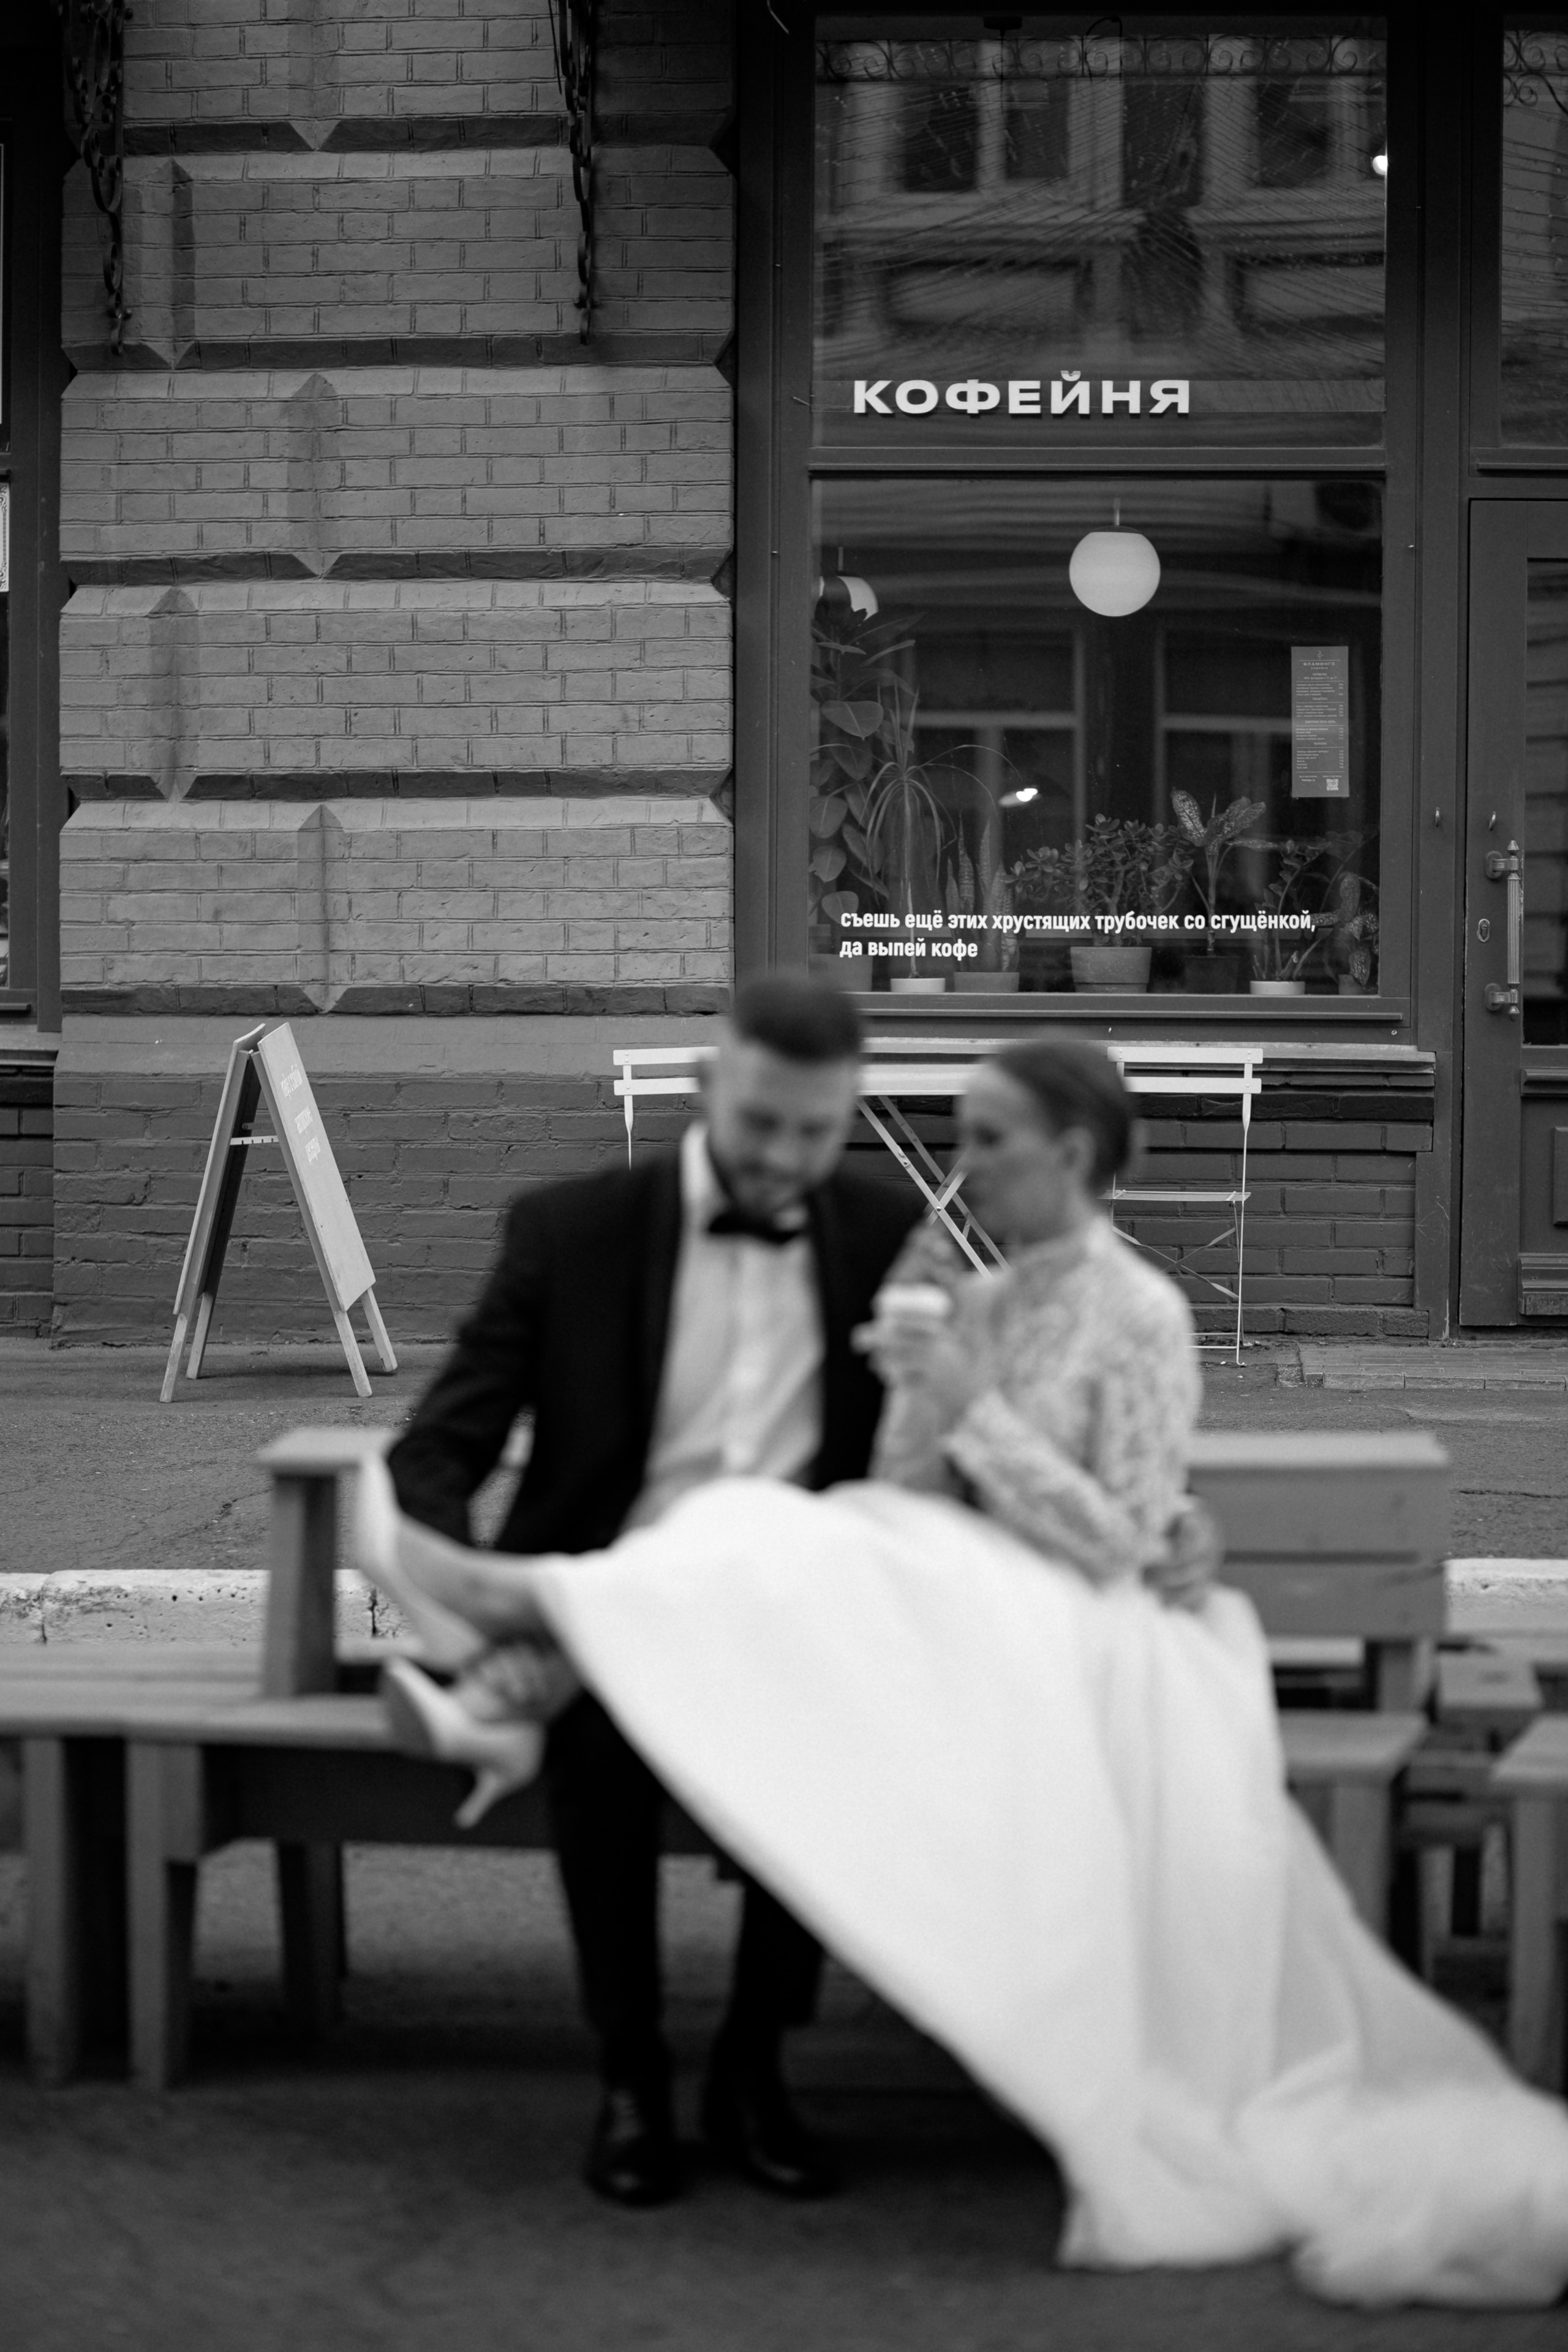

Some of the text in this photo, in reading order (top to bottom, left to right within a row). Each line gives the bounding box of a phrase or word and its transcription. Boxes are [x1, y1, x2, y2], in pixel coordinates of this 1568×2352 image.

[854, 370, 1189, 414] КОФЕЙНЯ
[840, 910, 1316, 934] съешь ещё этих хрустящих трубочек со сгущёнкой,
[839, 937, 978, 961] да выпей кофе
